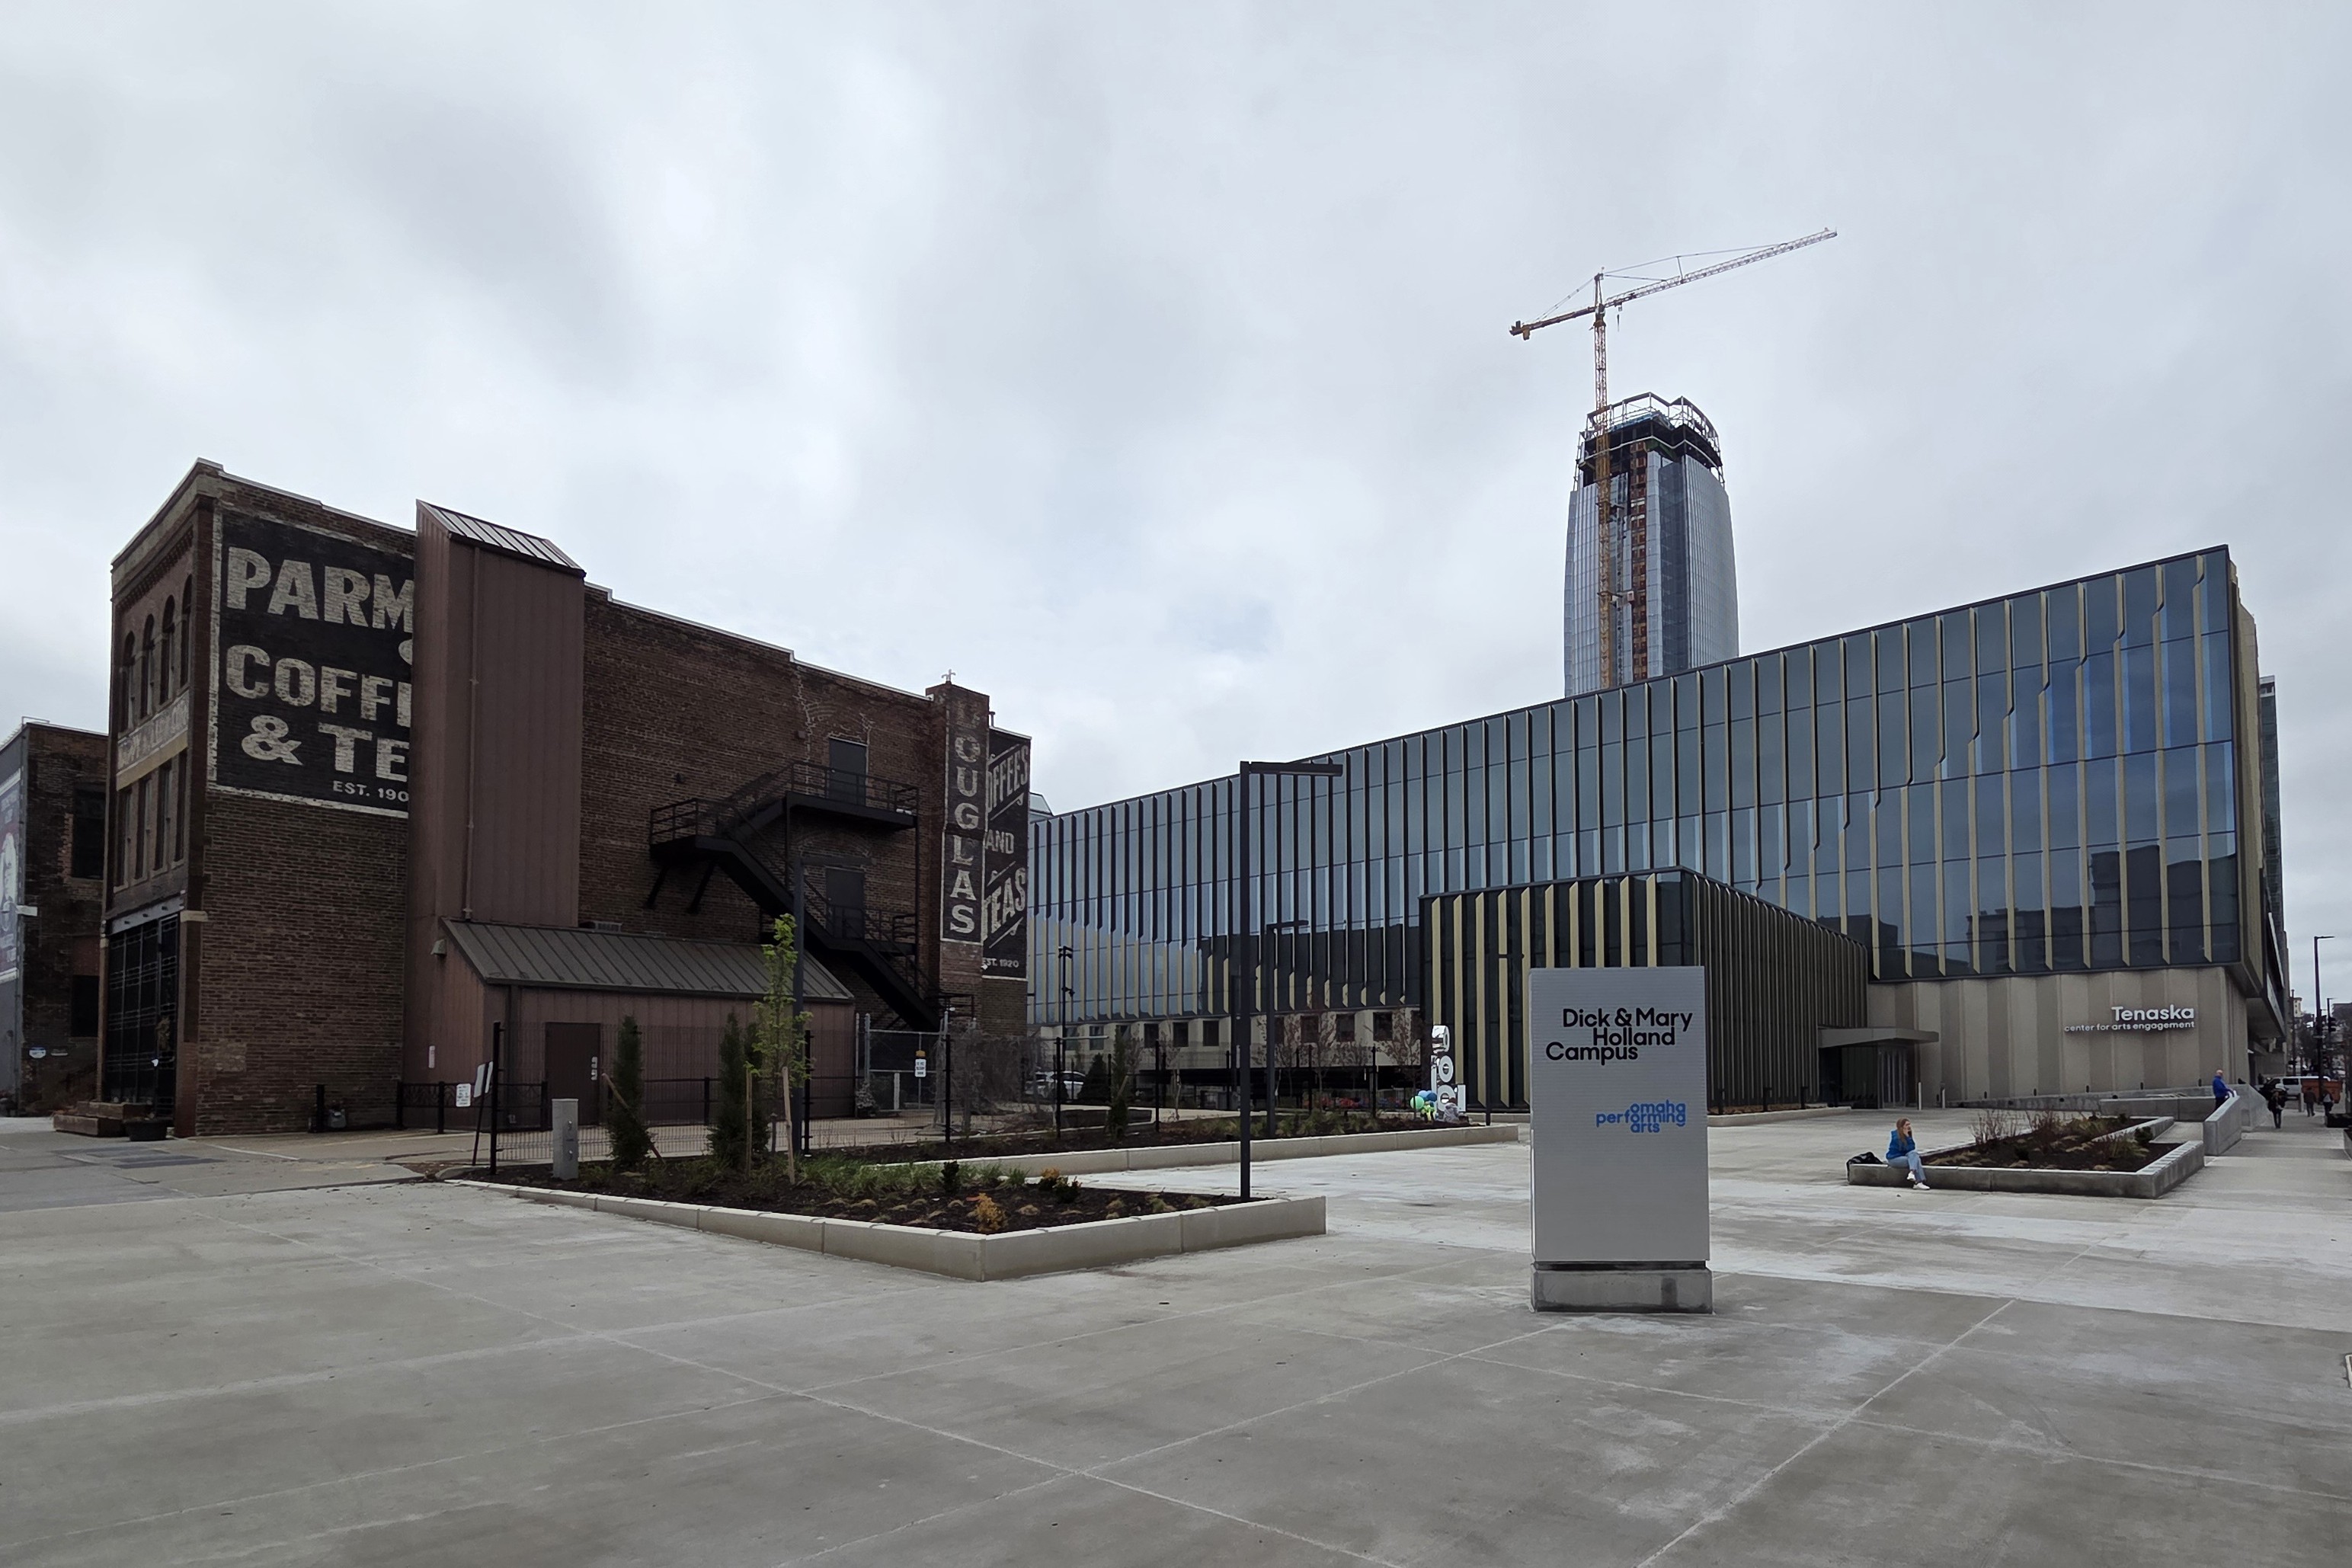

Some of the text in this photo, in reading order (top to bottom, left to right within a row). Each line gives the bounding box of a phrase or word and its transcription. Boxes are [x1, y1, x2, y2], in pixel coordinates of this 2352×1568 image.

[226, 546, 414, 633] PARM
[241, 714, 303, 766] &
[317, 721, 410, 782] TE
[332, 779, 371, 797] EST.
[984, 828, 1015, 854] AND
[981, 866, 1026, 943] TEAS
[1563, 1006, 1693, 1032] Dick & Mary
[2110, 1004, 2195, 1022] Tenaska
[1592, 1026, 1675, 1046] Holland
[2063, 1024, 2094, 1032] center
[2096, 1022, 2110, 1032] for
[2132, 1021, 2195, 1032] engagement
[1545, 1041, 1638, 1066] Campus
[1630, 1099, 1686, 1114] omaha
[1595, 1109, 1686, 1128] performing
[1630, 1122, 1660, 1133] arts
